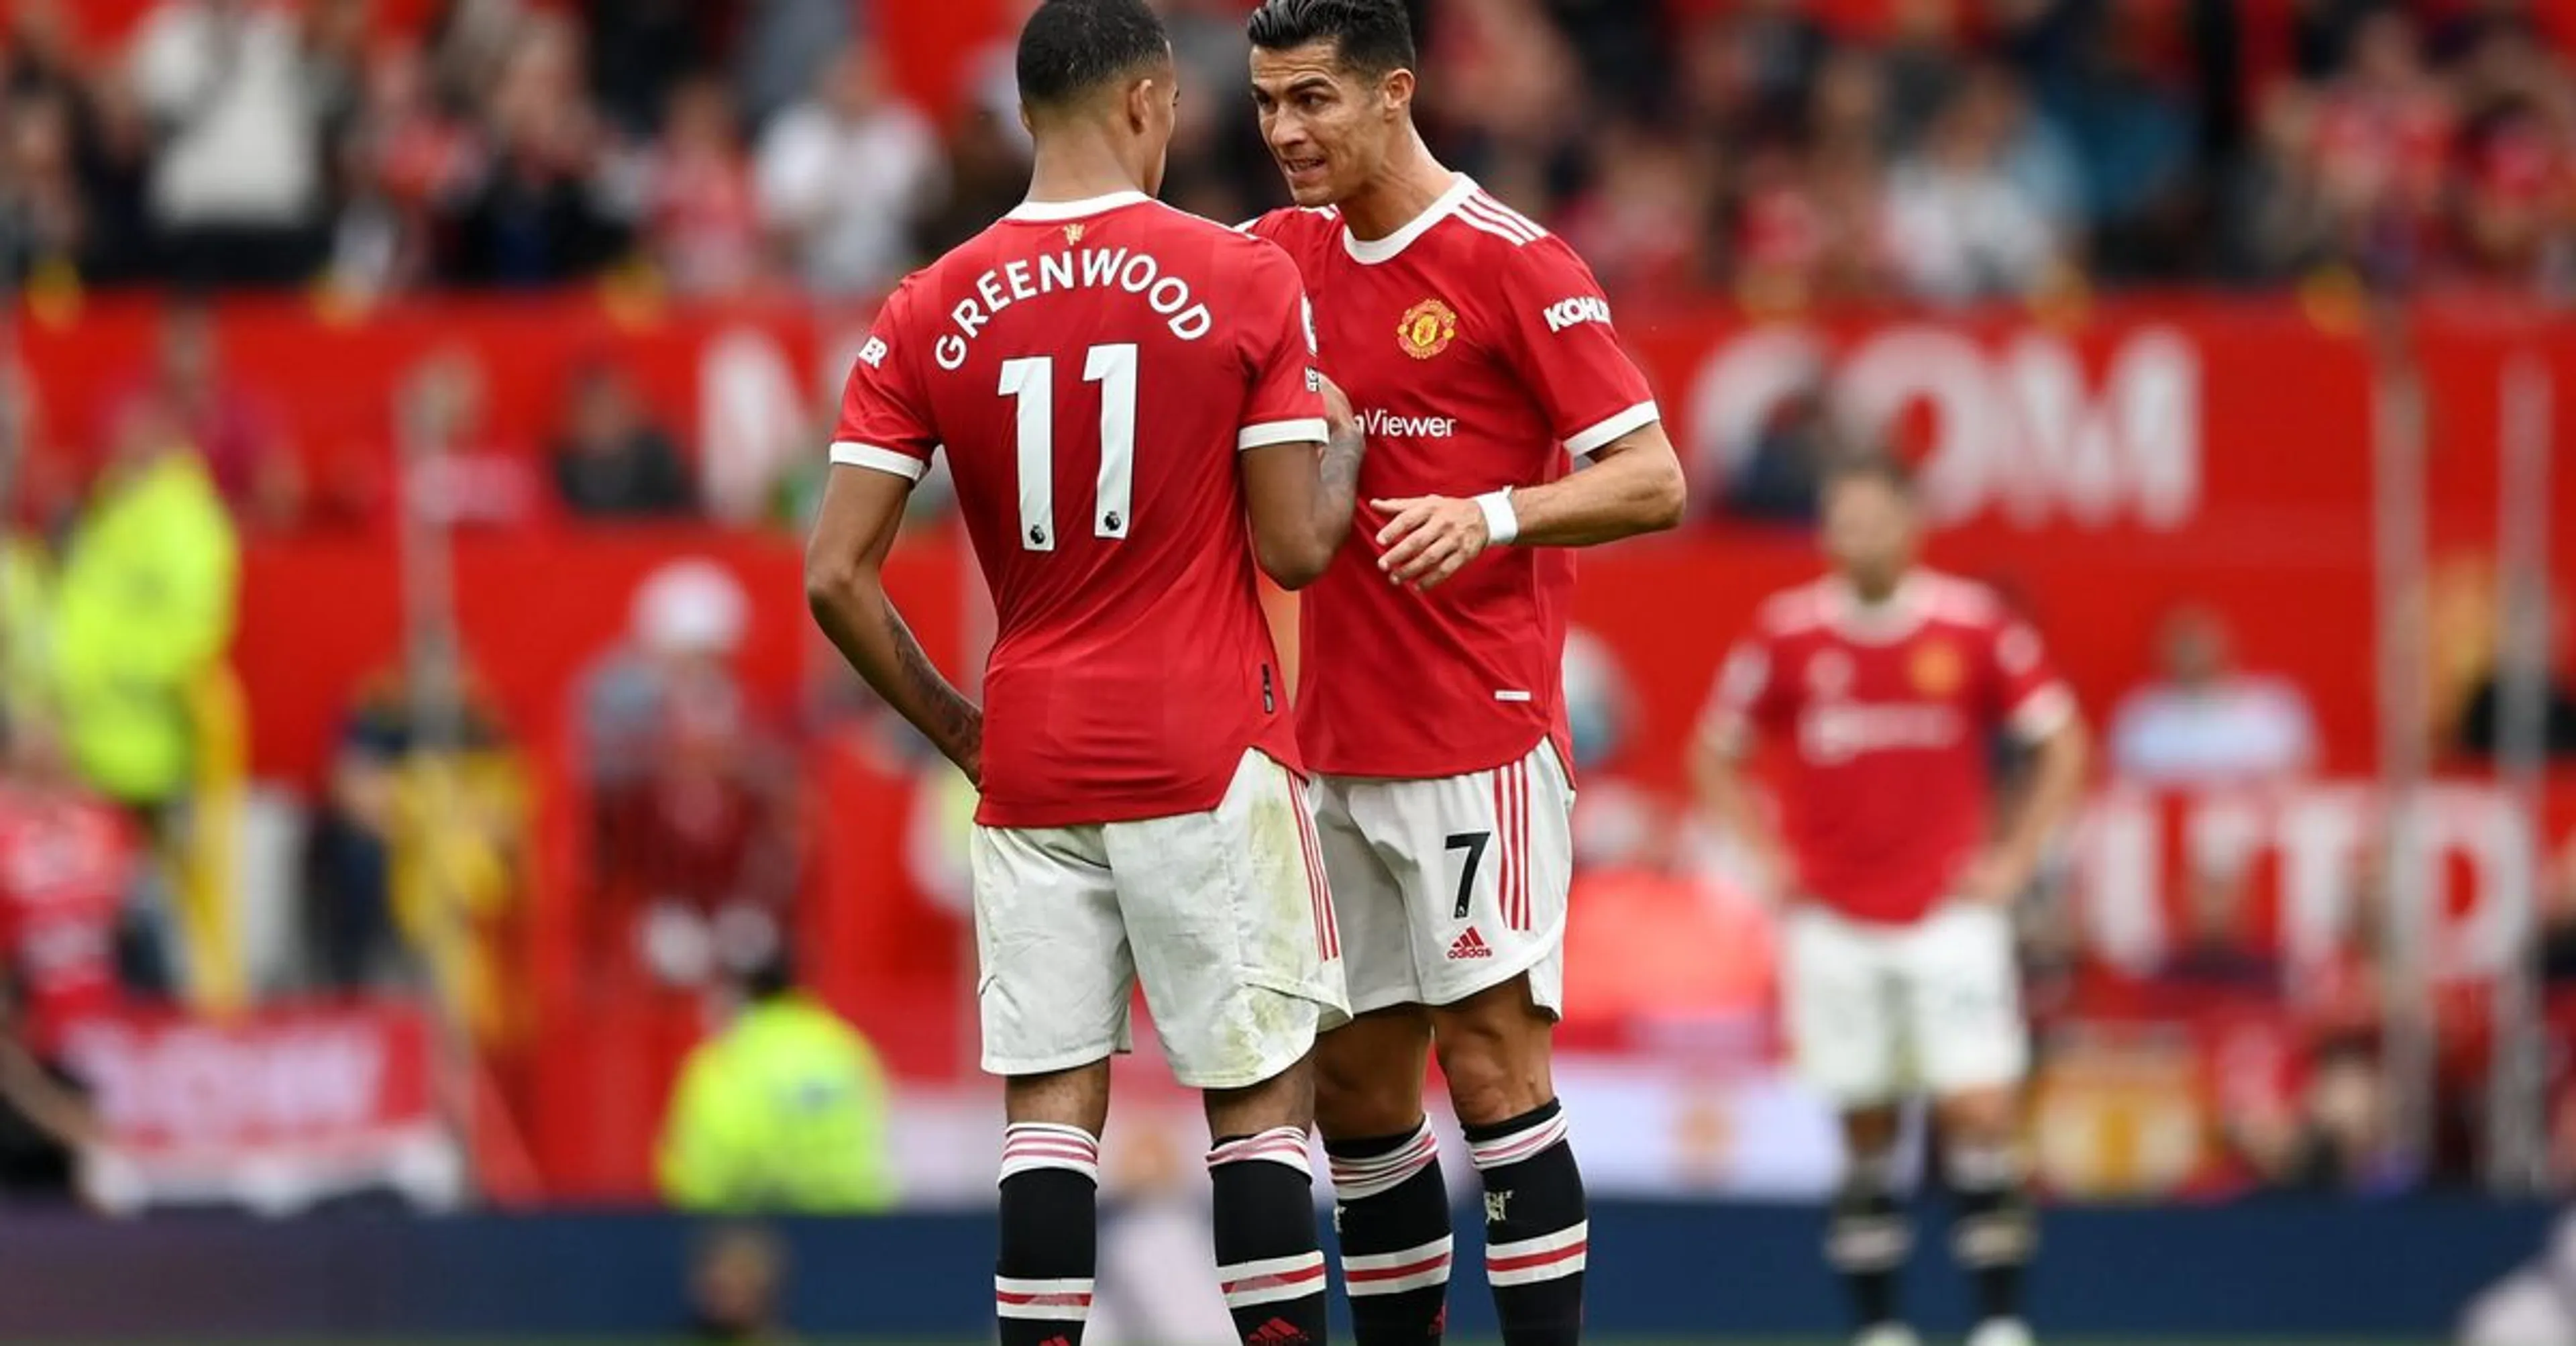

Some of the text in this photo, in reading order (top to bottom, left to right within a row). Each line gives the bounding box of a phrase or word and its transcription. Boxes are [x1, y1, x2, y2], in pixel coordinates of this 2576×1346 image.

[935, 248, 1212, 370] GREENWOOD
[998, 343, 1138, 551] 11
[1445, 831, 1491, 919] 7
[1447, 947, 1493, 960] adidas
